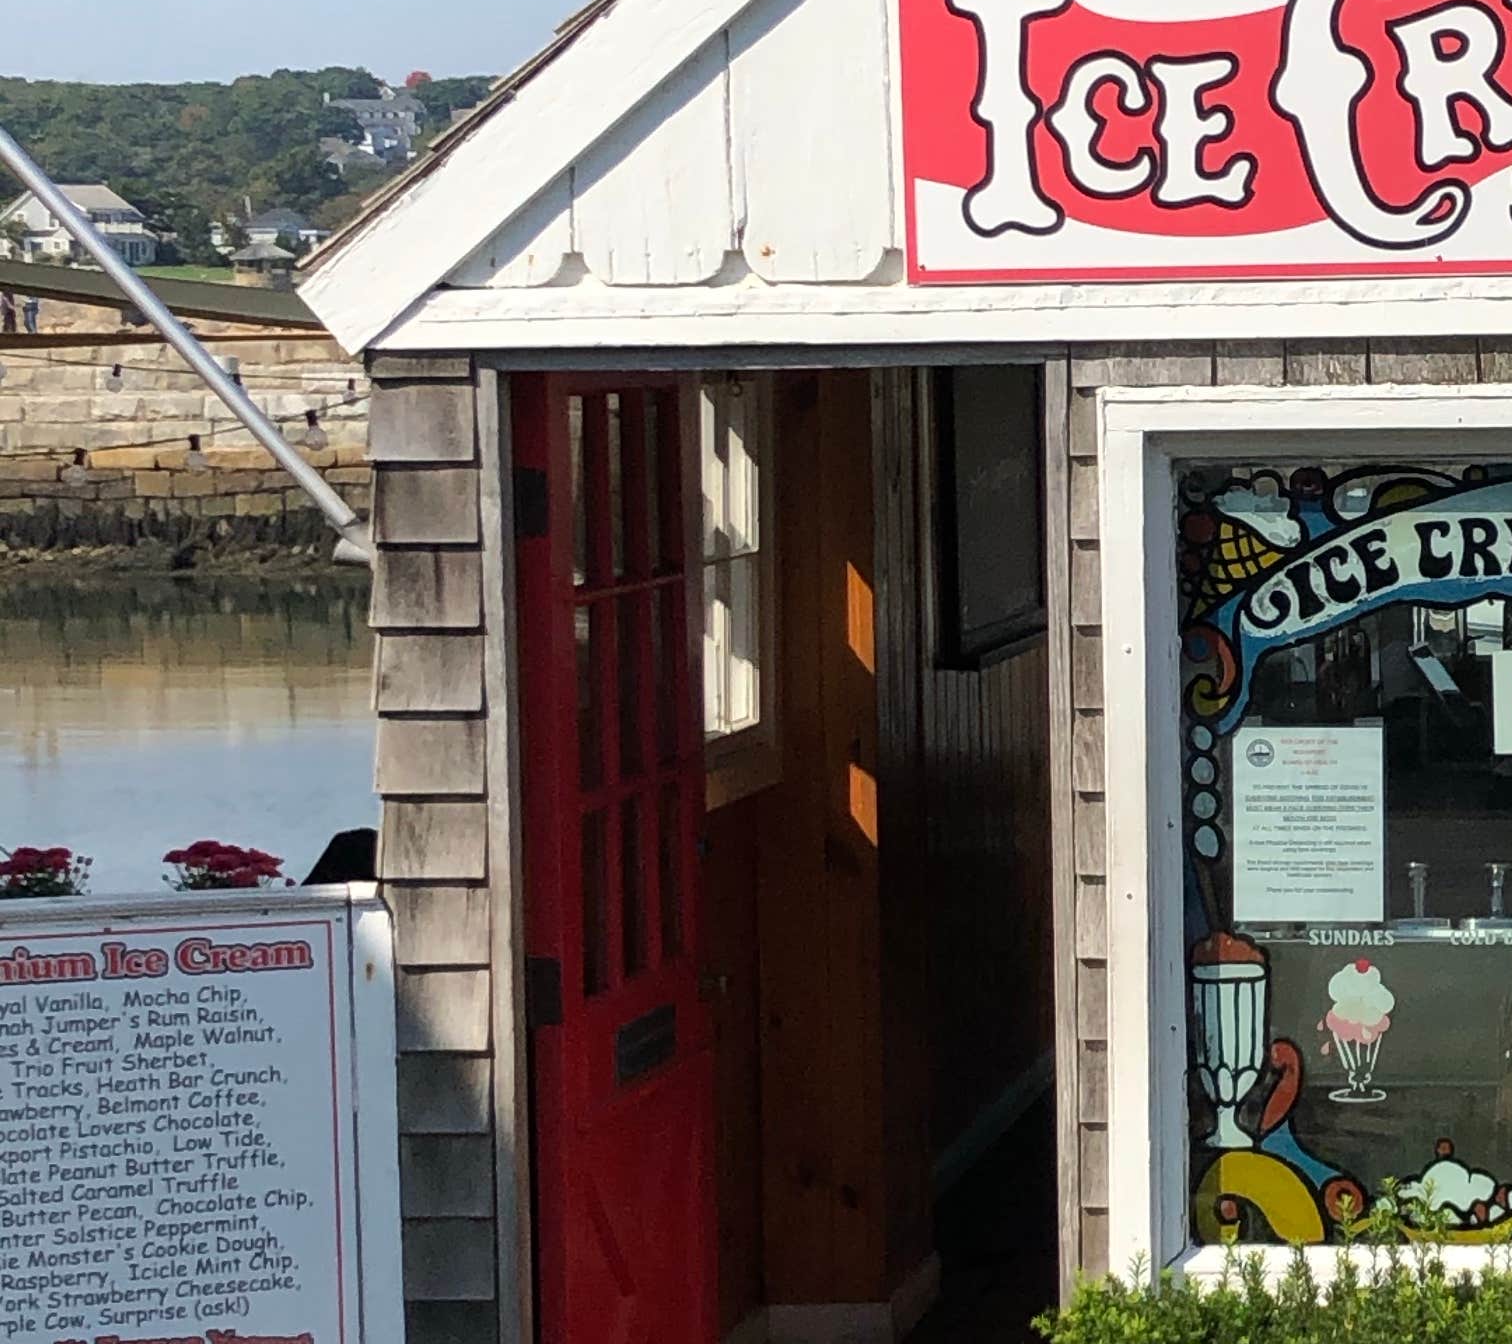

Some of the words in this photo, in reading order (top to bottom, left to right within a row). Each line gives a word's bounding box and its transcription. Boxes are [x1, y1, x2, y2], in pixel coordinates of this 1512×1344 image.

[1284, 526, 1401, 617] ICE
[1308, 928, 1395, 947] SUNDAES
[1448, 928, 1497, 946] COLD
[101, 942, 169, 979] Ice
[174, 937, 314, 975] Cream
[36, 991, 109, 1014] Vanilla,
[123, 988, 190, 1007] Mocha
[197, 984, 248, 1006] Chip,
[41, 1010, 140, 1037] Jumper's
[147, 1009, 190, 1027] Rum
[197, 1006, 264, 1026] Raisin,
[26, 1037, 41, 1056] &
[48, 1035, 120, 1055] Cream,
[134, 1030, 194, 1054] Maple
[9, 1059, 55, 1078] Trio
[62, 1055, 113, 1075] Fruit
[97, 1075, 160, 1095] Heath
[168, 1071, 204, 1089] Bar
[98, 1096, 181, 1116] Belmont
[77, 1119, 146, 1138] Lovers
[173, 1134, 212, 1153] Low
[48, 1162, 118, 1182] Peanut
[126, 1157, 195, 1177] Butter
[0, 1184, 64, 1207] Salted
[71, 1177, 153, 1201] Caramel
[161, 1172, 239, 1194] Truffle
[2, 1208, 71, 1228] Butter
[157, 1193, 257, 1216] Chocolate
[52, 1224, 137, 1246] Solstice
[27, 1243, 134, 1269] Monster's
[142, 1237, 209, 1259] Cookie
[128, 1259, 187, 1281] Icicle
[195, 1256, 241, 1276] Mint
[47, 1284, 168, 1309] Strawberry
[98, 1304, 188, 1328] Surprise
[194, 1296, 251, 1322] (ask!)
